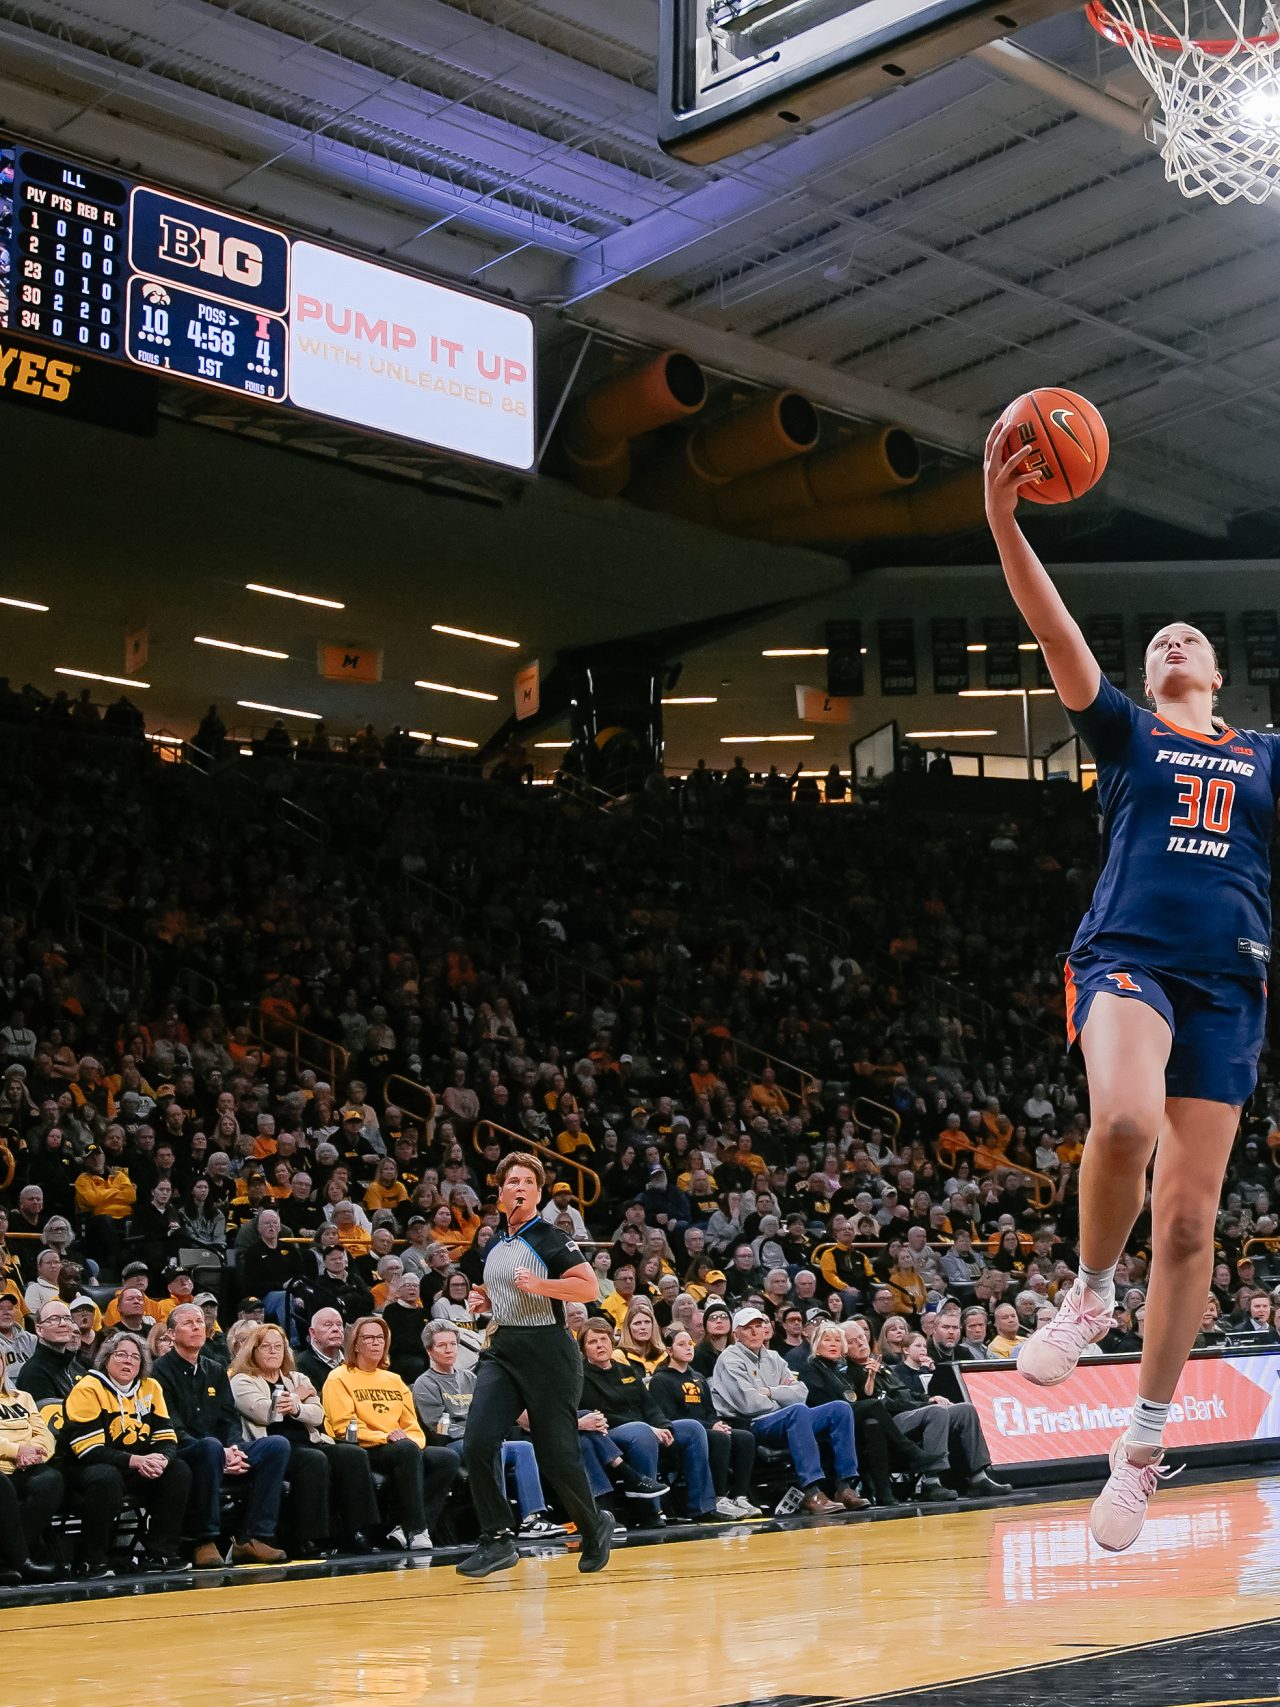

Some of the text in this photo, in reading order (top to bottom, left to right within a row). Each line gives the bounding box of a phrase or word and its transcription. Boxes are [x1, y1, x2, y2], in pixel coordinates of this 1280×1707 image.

[63, 169, 86, 188] ILL
[27, 186, 116, 227] PLY PTS REB FL
[31, 212, 113, 251] 1 0 0 0
[30, 236, 112, 275] 2 2 0 0
[24, 260, 111, 301] 23 0 1 0
[22, 284, 110, 325] 30 2 2 0
[142, 304, 226, 336] 10 POSS
[21, 310, 110, 350] 34 0 0 0
[187, 320, 270, 366] 4:58 4
[297, 293, 527, 385] PUMP IT UP
[138, 350, 170, 369] FOULS 1
[198, 356, 223, 378] 1ST
[297, 333, 362, 370] WITH
[369, 357, 494, 407] UNLEADED
[245, 380, 274, 396] FOULS 0
[1155, 749, 1256, 777] FIGHTING
[1169, 773, 1236, 834] 30
[1166, 837, 1230, 858] ILLINI
[353, 1388, 403, 1401] HAWKEYES
[1025, 1394, 1227, 1434] First Intere Bank
